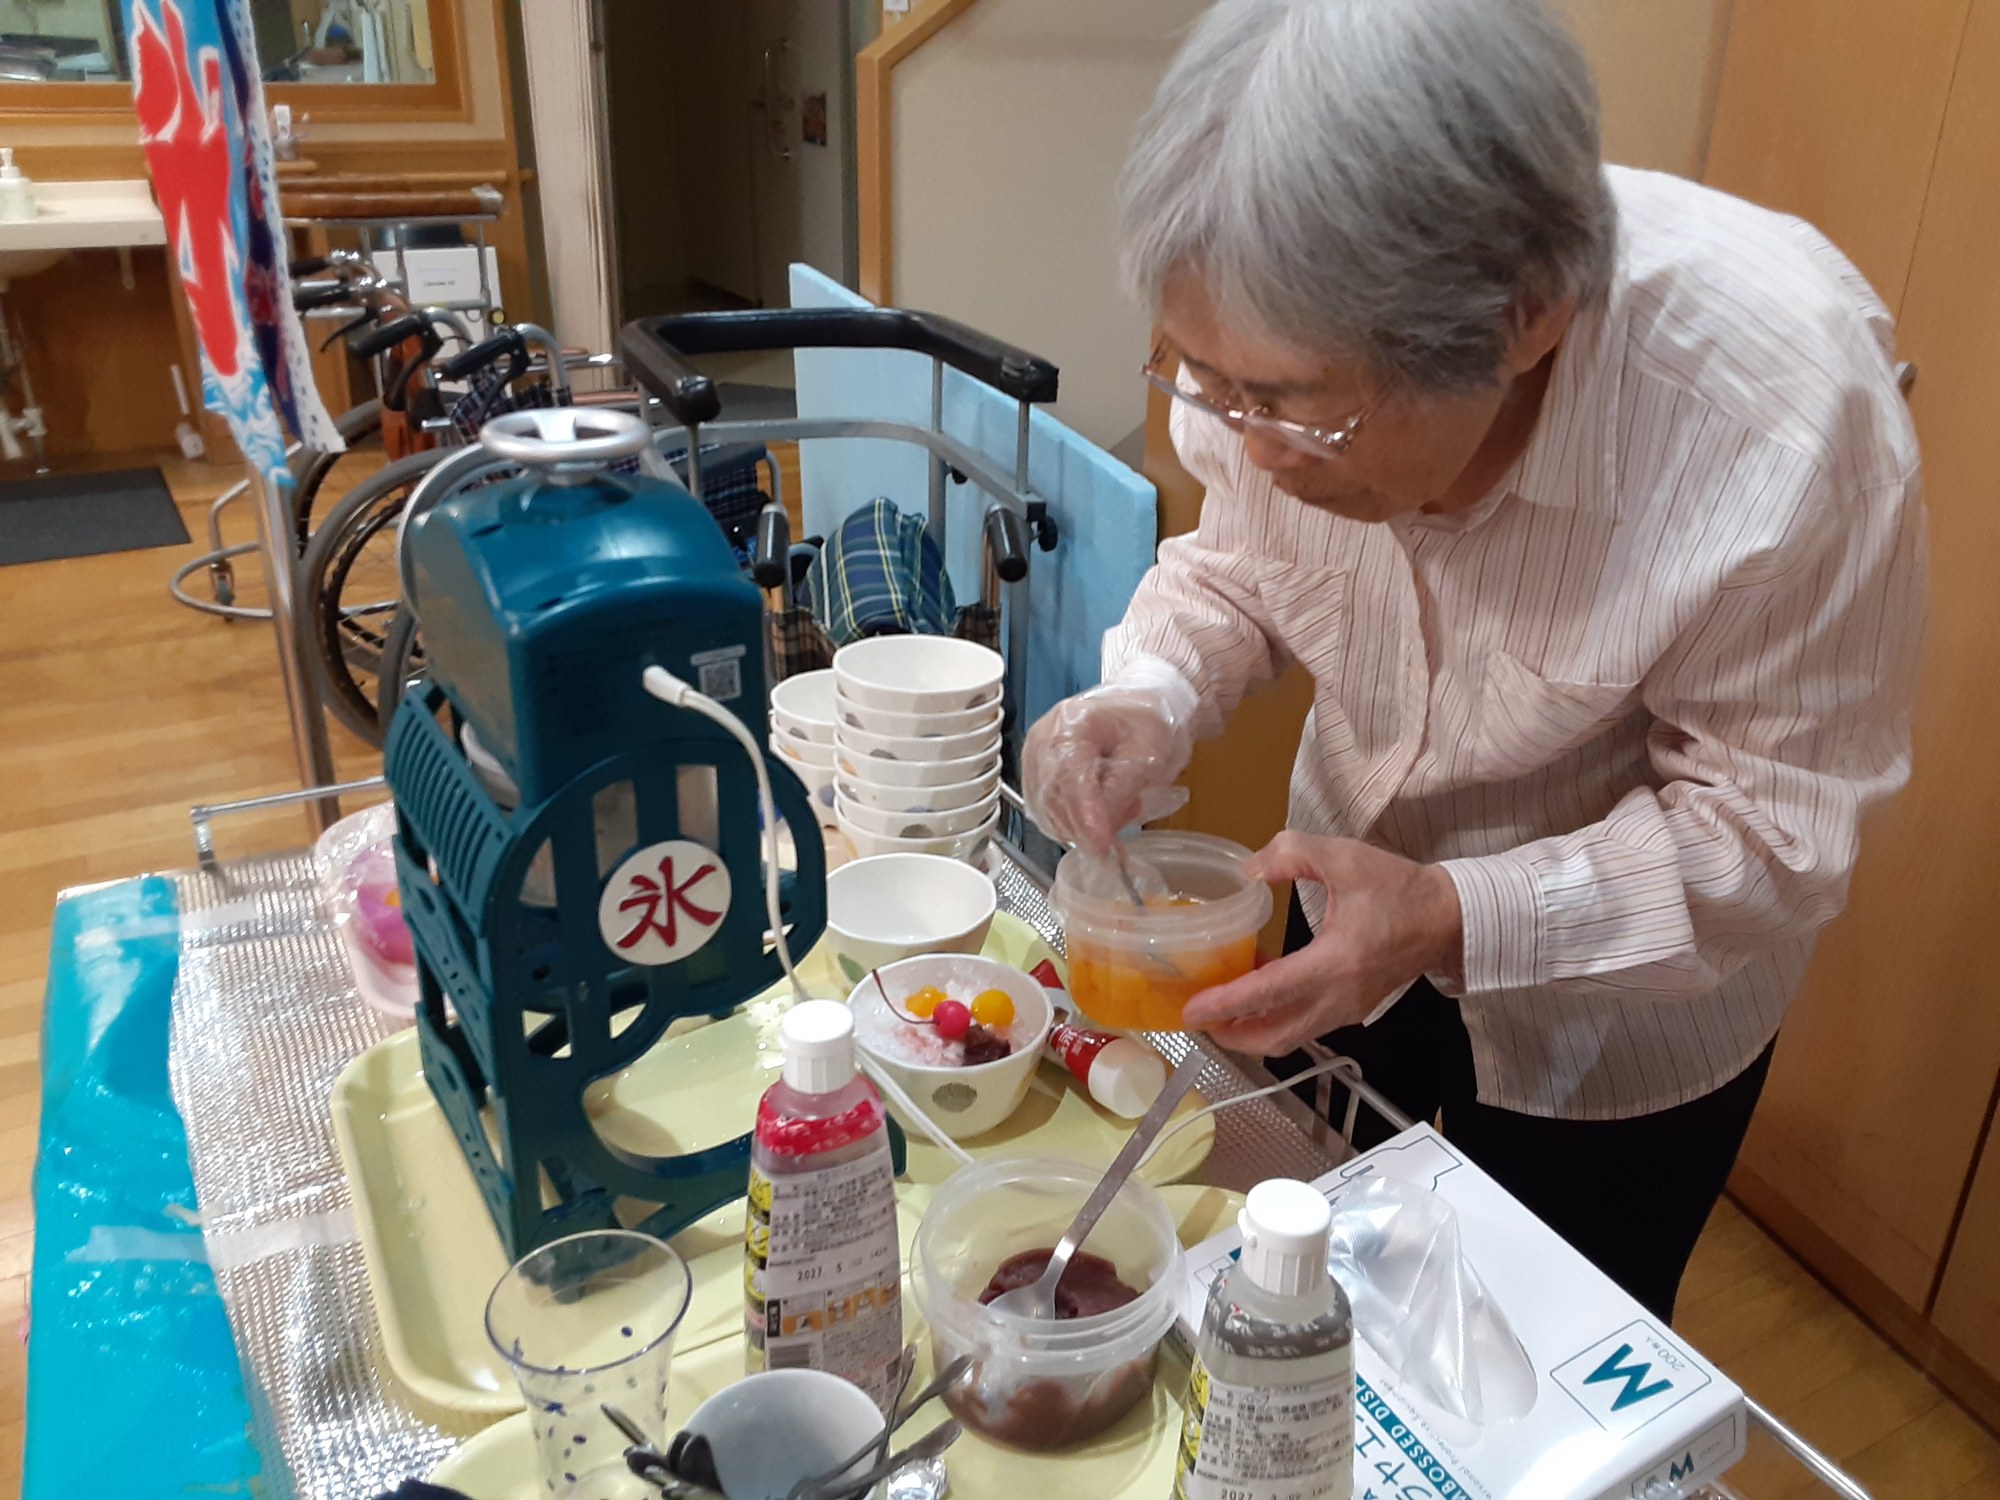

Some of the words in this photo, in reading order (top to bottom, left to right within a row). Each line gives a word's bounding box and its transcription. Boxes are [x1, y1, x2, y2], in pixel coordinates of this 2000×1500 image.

[615, 855, 722, 949] 氷
[797, 1267, 822, 1281] 2027
[1584, 1343, 1674, 1411] M
